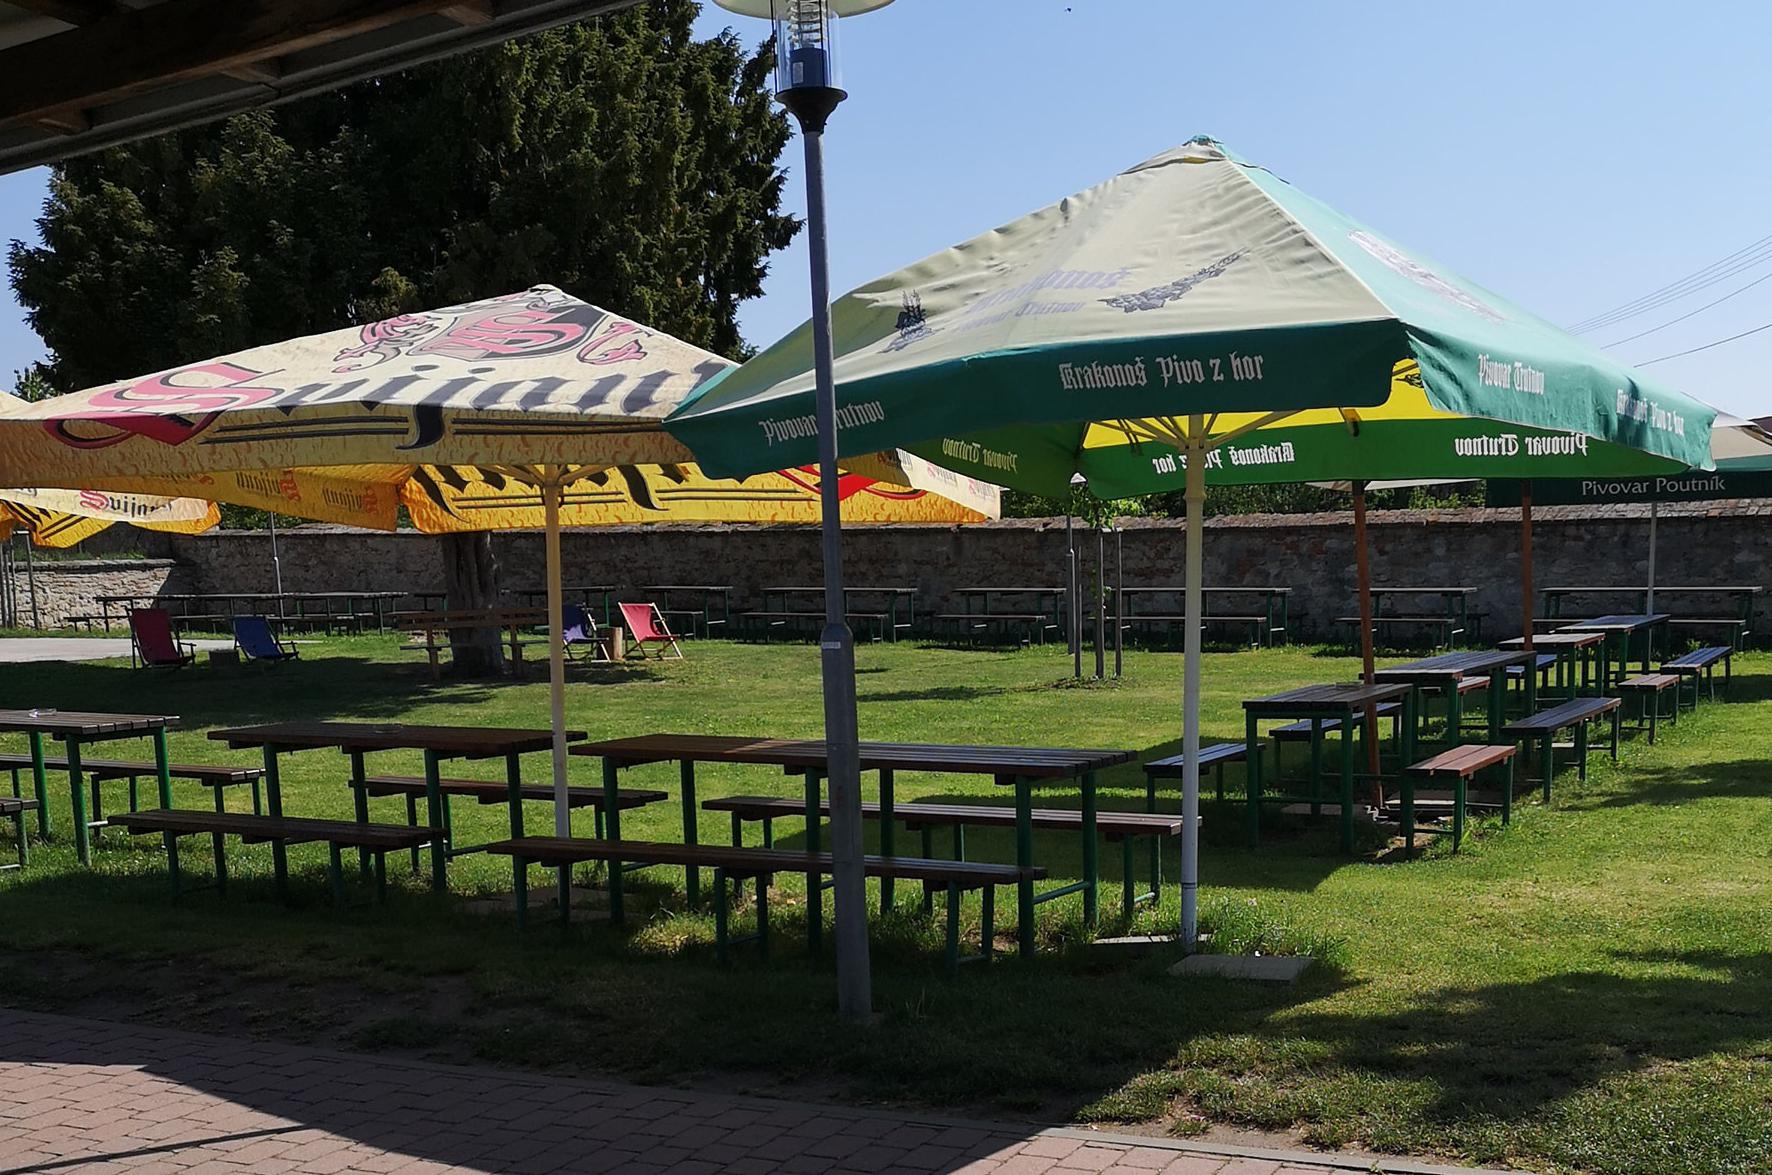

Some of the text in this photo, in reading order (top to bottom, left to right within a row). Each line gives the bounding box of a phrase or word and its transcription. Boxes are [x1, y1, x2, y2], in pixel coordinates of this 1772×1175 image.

[1059, 351, 1264, 390] Krakonoš Pivo z hor
[836, 400, 885, 430] rutnov
[1582, 475, 1726, 496] Pivovar Poutník
